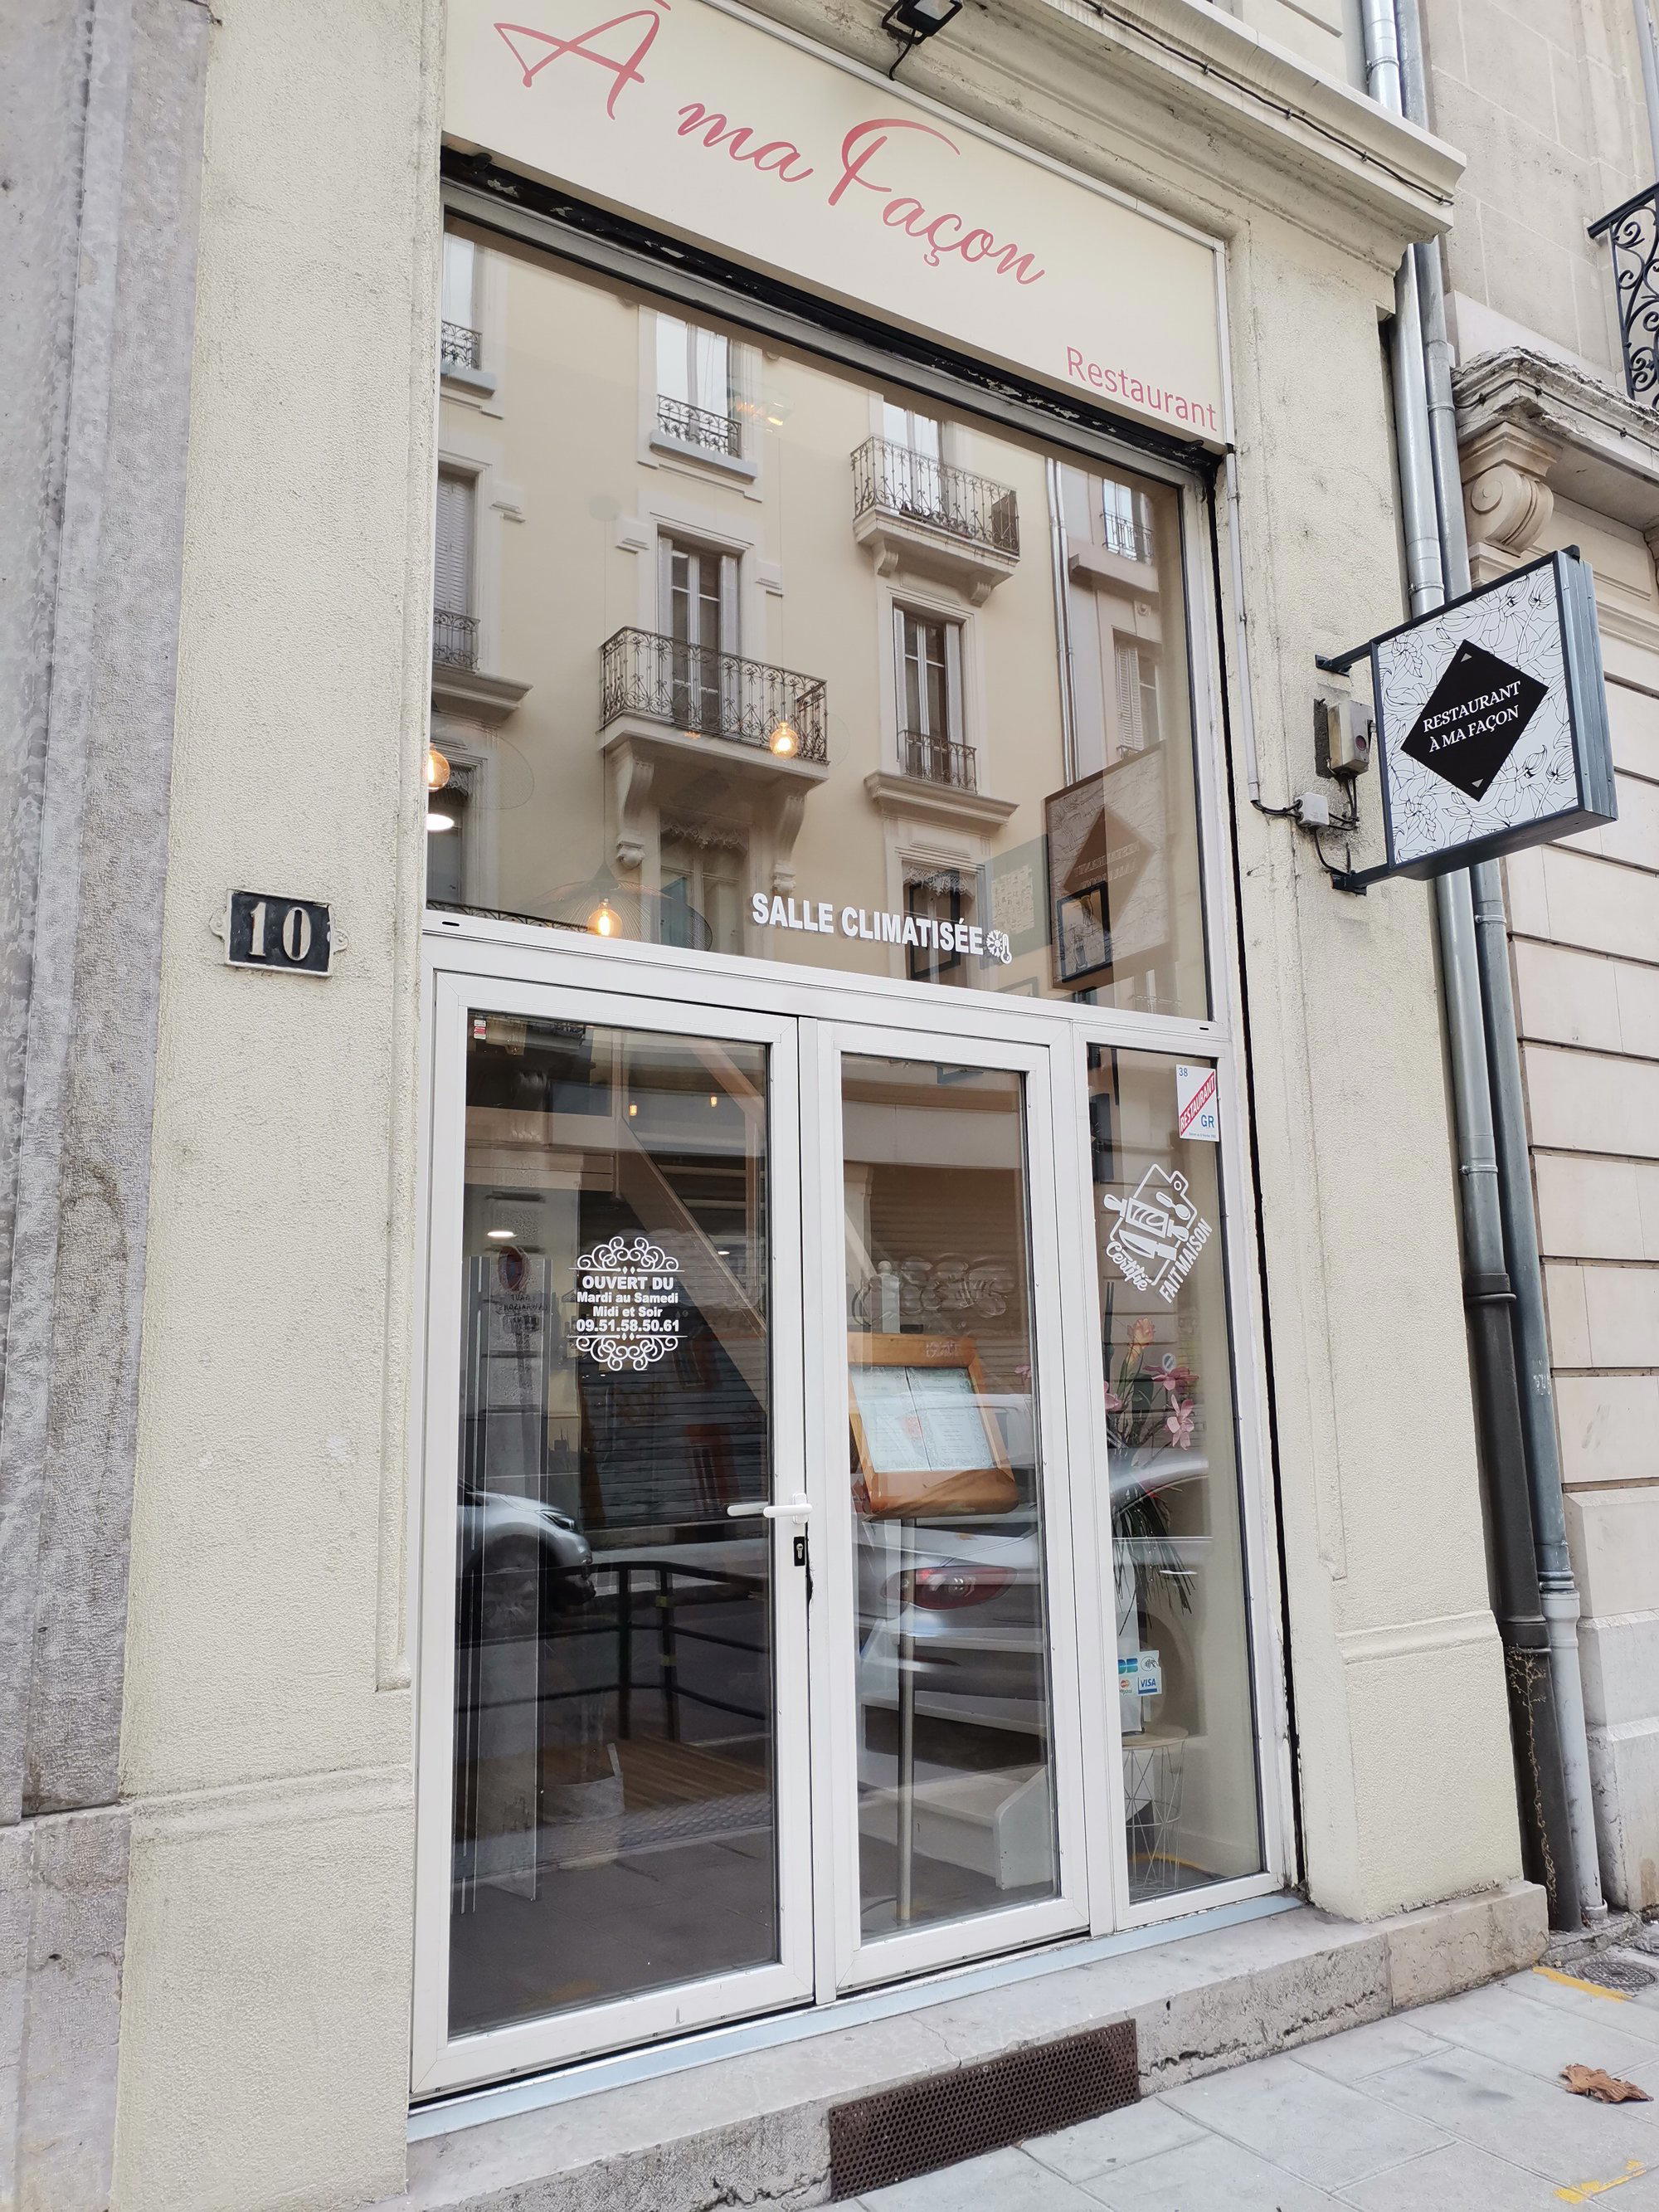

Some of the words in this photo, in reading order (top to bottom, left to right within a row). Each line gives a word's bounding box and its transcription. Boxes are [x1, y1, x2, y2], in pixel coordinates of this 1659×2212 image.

[677, 102, 813, 183] ma
[828, 118, 1045, 285] Façon
[1067, 346, 1217, 432] Restaurant
[1423, 680, 1520, 733] RESTAURANT
[1429, 736, 1441, 753] À
[1442, 728, 1467, 748] MA
[1467, 704, 1519, 737] FAÇON
[250, 902, 311, 961] 10
[752, 893, 834, 933] SALLE
[841, 907, 984, 955] CLIMATISÉE
[1179, 1067, 1189, 1077] 38
[1180, 1076, 1215, 1131] RESTAURANT
[1201, 1114, 1215, 1128] GR
[582, 1275, 648, 1289] OUVERT
[652, 1277, 674, 1290] DU
[1106, 1240, 1151, 1291] Certifié
[1159, 1266, 1184, 1303] FAIT
[1175, 1217, 1213, 1277] MAISON
[577, 1292, 612, 1303] Mardi
[615, 1294, 630, 1303] au
[634, 1293, 679, 1303] Samedi
[592, 1306, 619, 1317] Midi
[622, 1307, 635, 1317] et
[638, 1306, 663, 1317] Soir
[576, 1318, 679, 1332] 09.51.58.50.61
[1140, 1678, 1156, 1687] VISA
